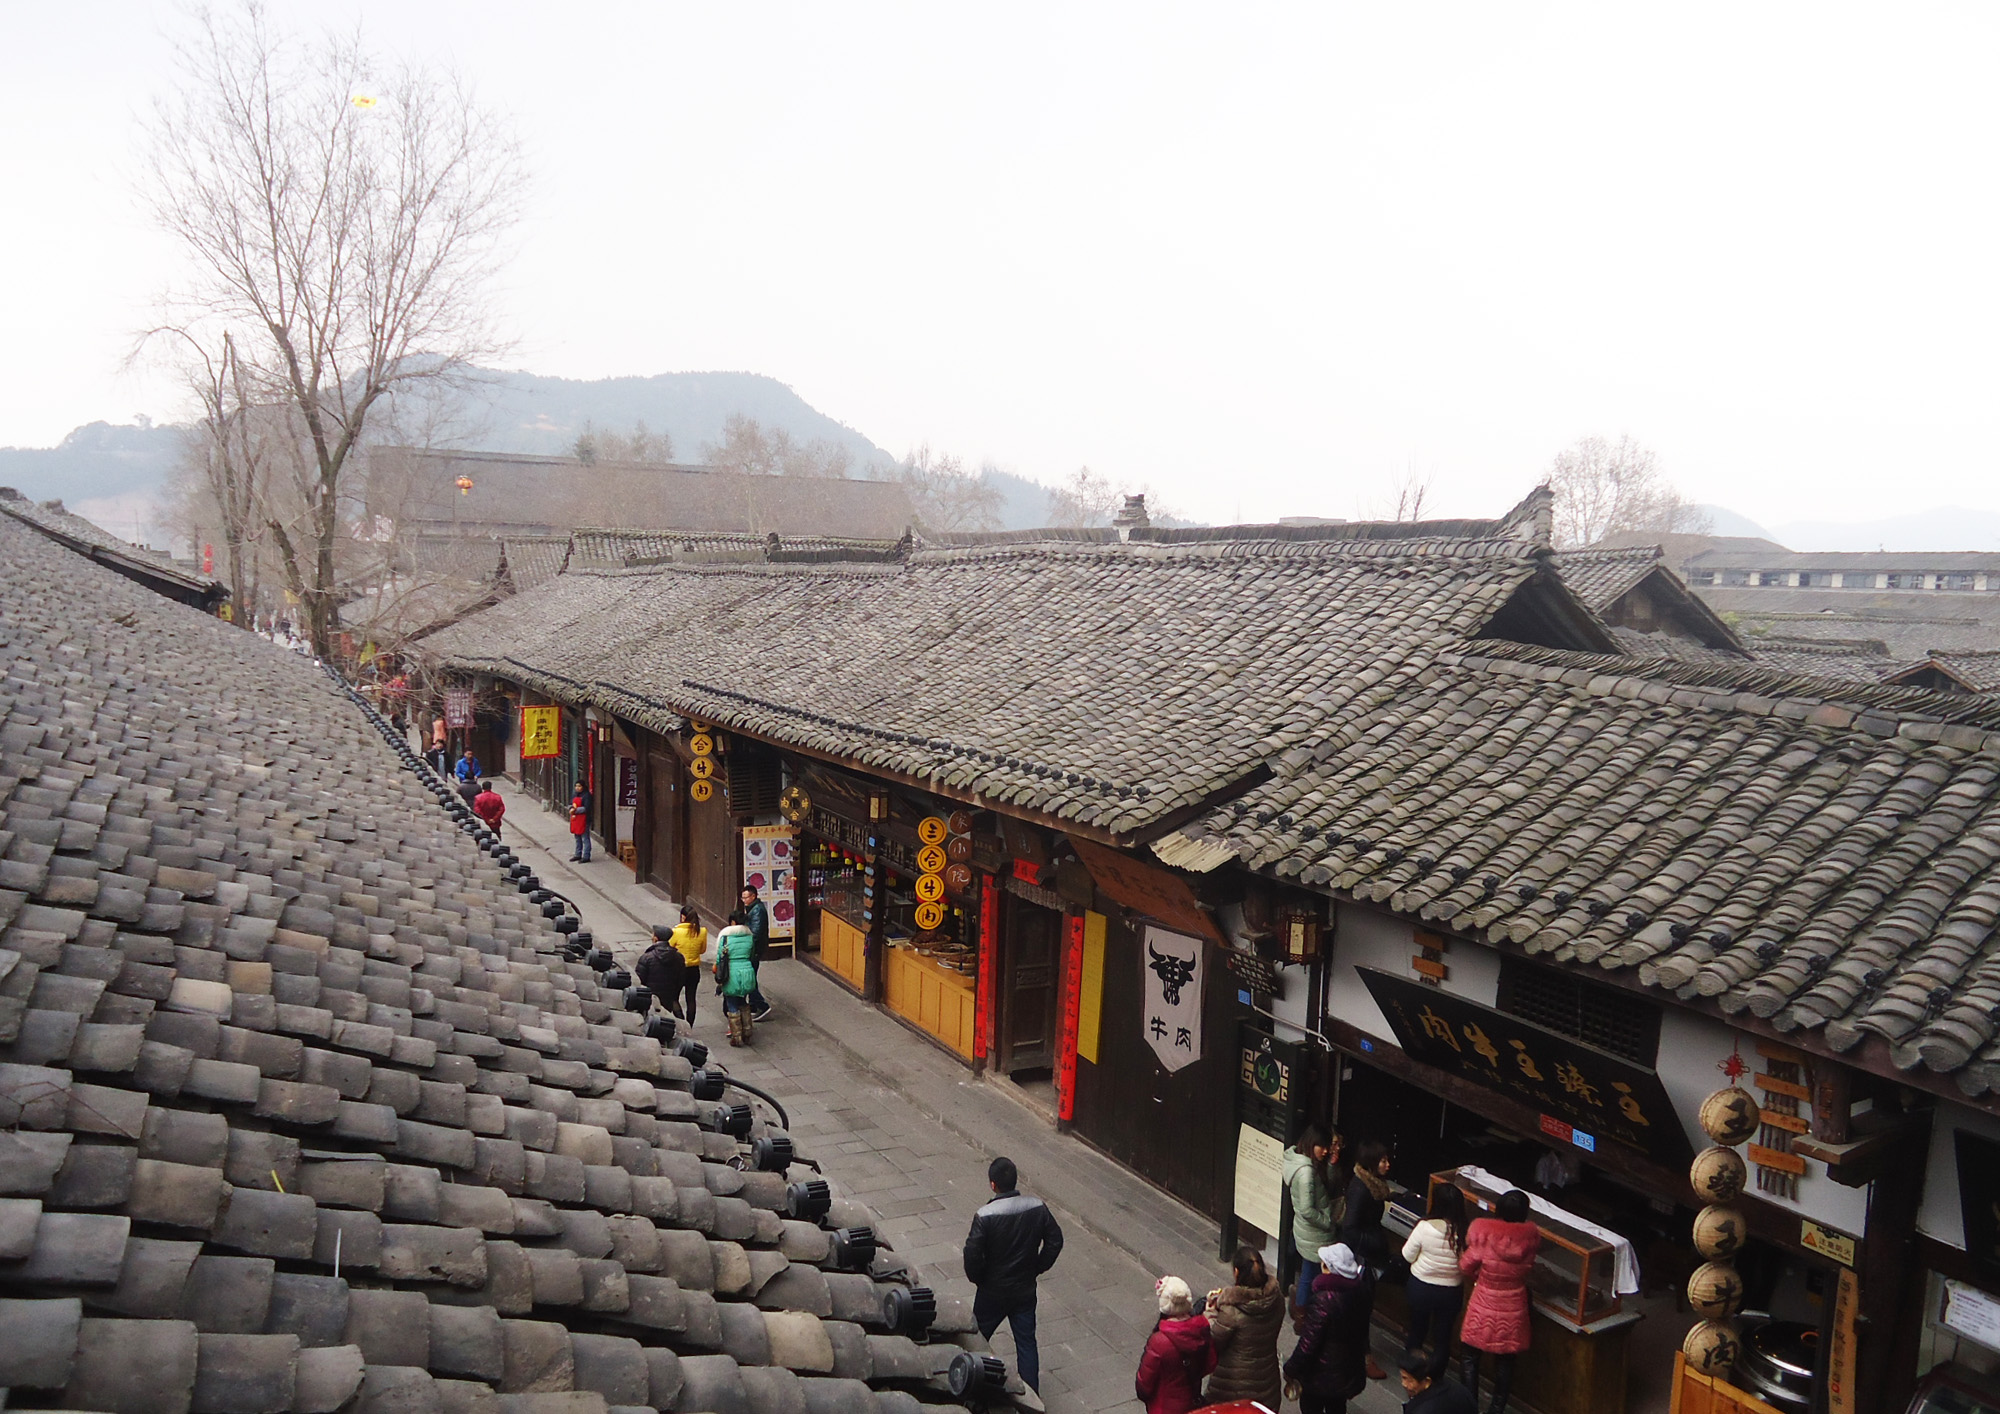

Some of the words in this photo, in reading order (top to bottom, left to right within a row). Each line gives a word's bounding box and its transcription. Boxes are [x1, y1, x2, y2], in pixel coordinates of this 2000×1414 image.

[924, 823, 939, 922] 三合牛肉
[1151, 1016, 1192, 1052] 牛肉
